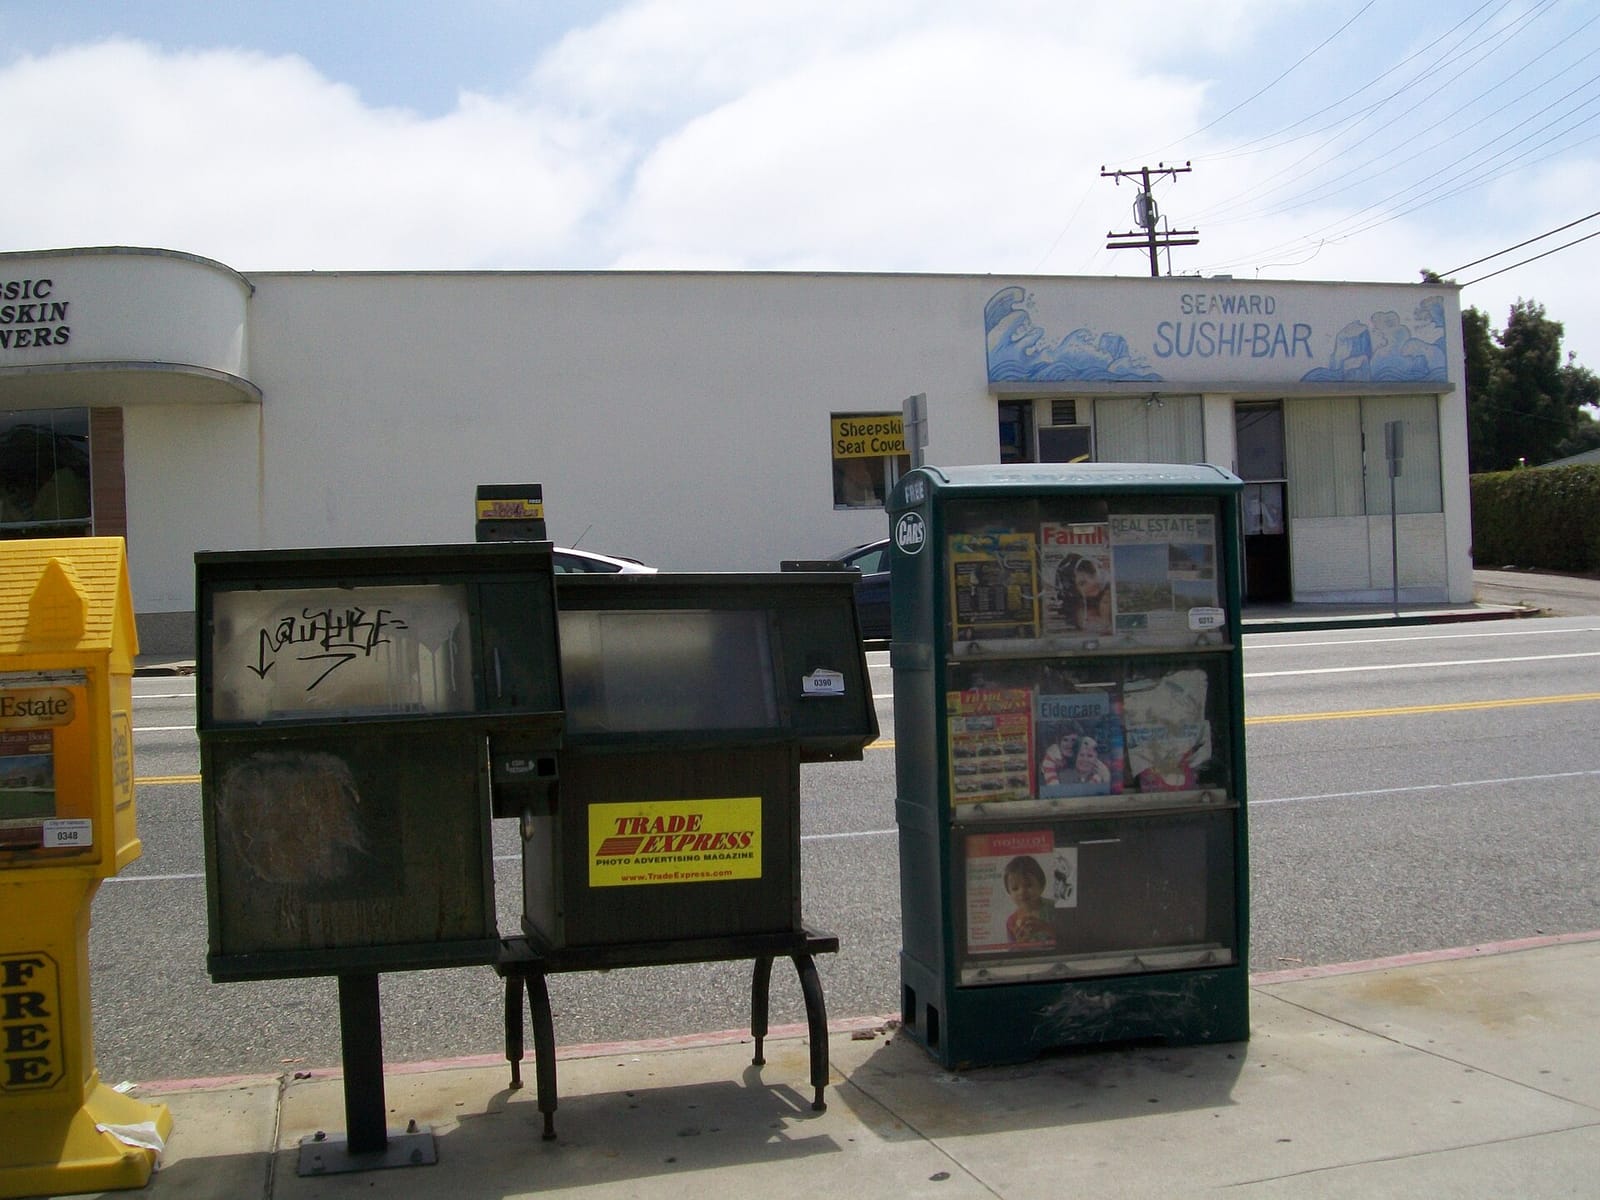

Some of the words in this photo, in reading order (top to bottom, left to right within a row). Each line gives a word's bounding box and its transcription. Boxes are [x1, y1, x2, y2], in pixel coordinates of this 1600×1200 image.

[0, 279, 52, 300] SIC
[1180, 293, 1276, 315] SEAWARD
[1152, 320, 1314, 359] SUSHI-BAR
[840, 419, 904, 438] Sheepski
[837, 439, 867, 454] Seat
[899, 520, 924, 546] CARS
[1111, 517, 1145, 535] REAL
[1147, 518, 1195, 533] ESTATE
[814, 679, 832, 687] 0390
[0, 695, 68, 718] Estate
[615, 814, 703, 835] TRADE
[57, 831, 79, 841] 0348
[639, 831, 754, 854] EXPRESS
[596, 858, 631, 866] PHOTO
[634, 855, 700, 864] ADVERTISING
[704, 851, 754, 861] MAGAZINE
[621, 869, 733, 882] www.TradeExpress.com
[0, 959, 52, 1086] FREE
